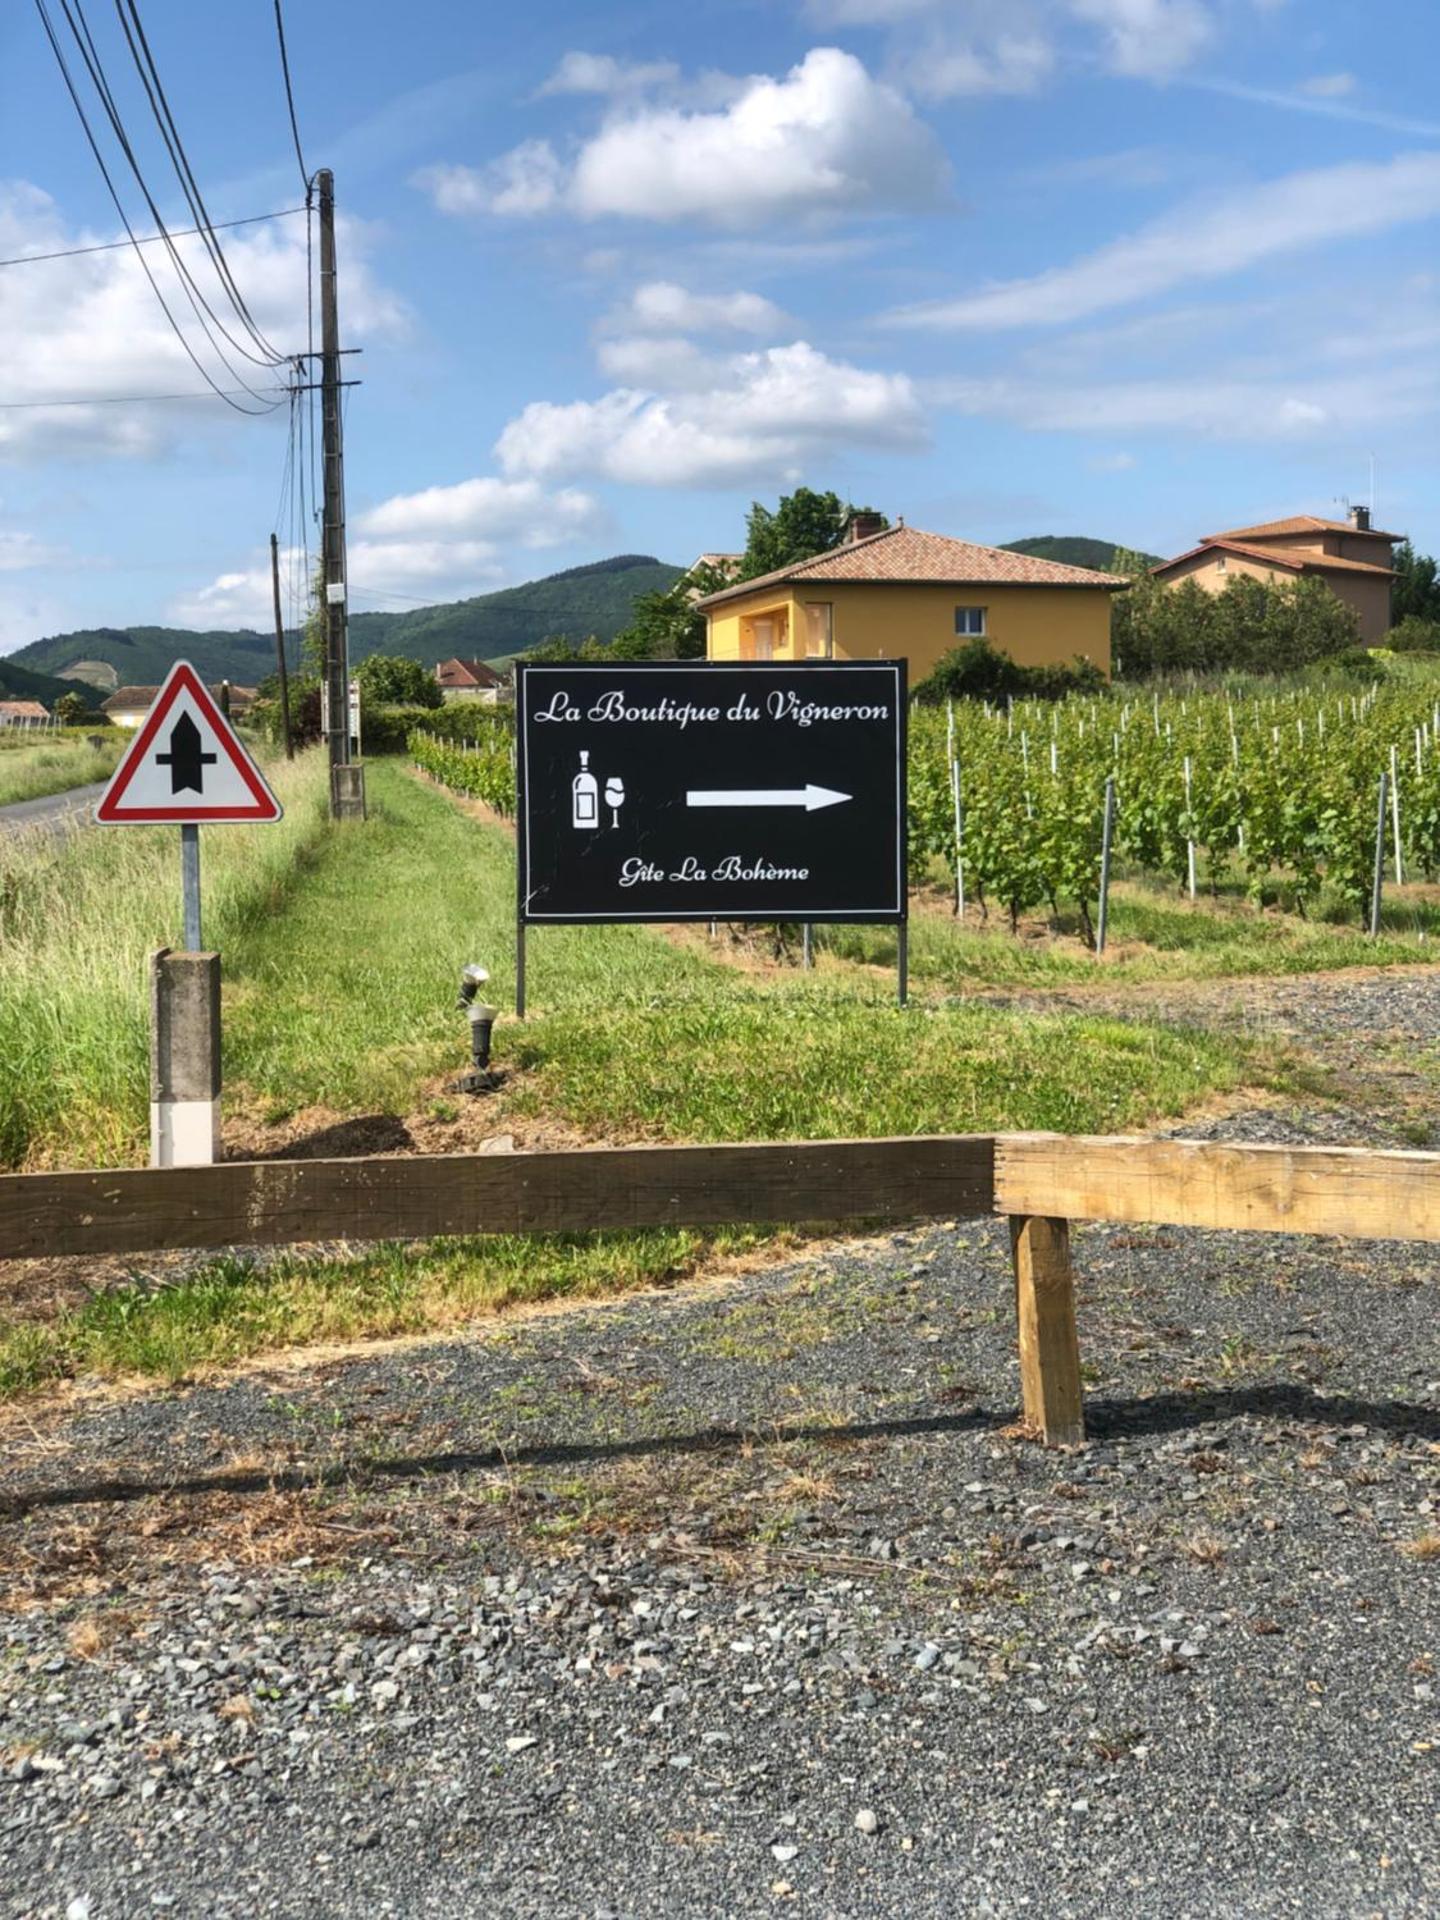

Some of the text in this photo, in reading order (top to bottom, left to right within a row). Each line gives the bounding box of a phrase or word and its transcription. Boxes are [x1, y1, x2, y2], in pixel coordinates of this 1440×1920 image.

[533, 690, 889, 730] La Boutique du Vigneron
[618, 855, 809, 887] Gîte La Bohème
